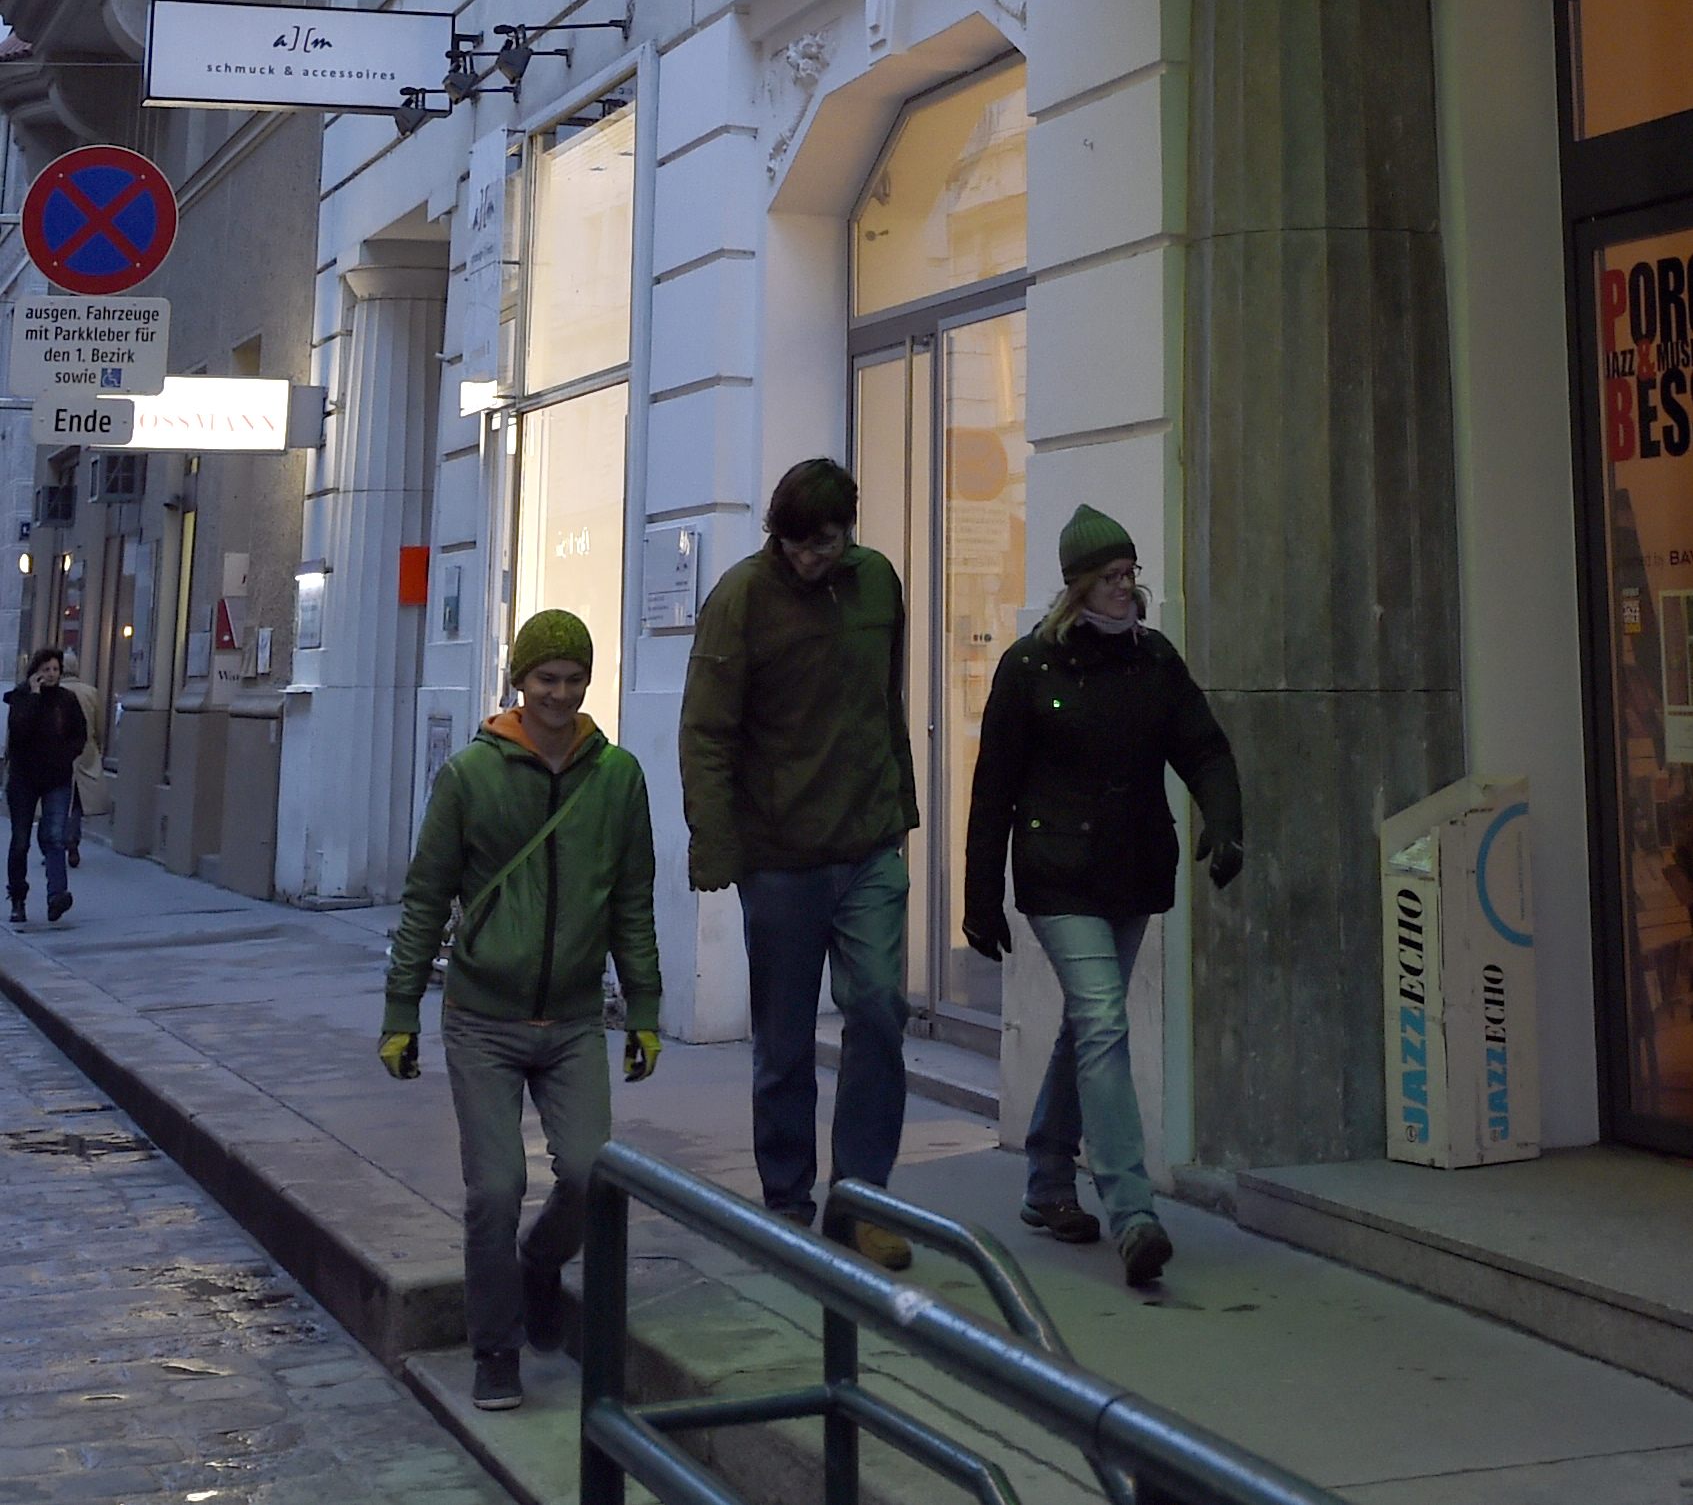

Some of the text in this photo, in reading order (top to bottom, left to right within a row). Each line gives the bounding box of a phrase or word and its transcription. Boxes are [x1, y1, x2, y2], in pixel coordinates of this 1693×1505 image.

[206, 62, 395, 80] schmuck & accessoires
[25, 306, 159, 324] ausgen. Fahrzeuge
[25, 326, 156, 342] mit Parkkleber für
[44, 348, 135, 363] den 1. Bezirk
[54, 368, 96, 384] sowie
[54, 409, 111, 433] Ende
[139, 413, 275, 432] OSSMANN
[1607, 368, 1693, 463] BES
